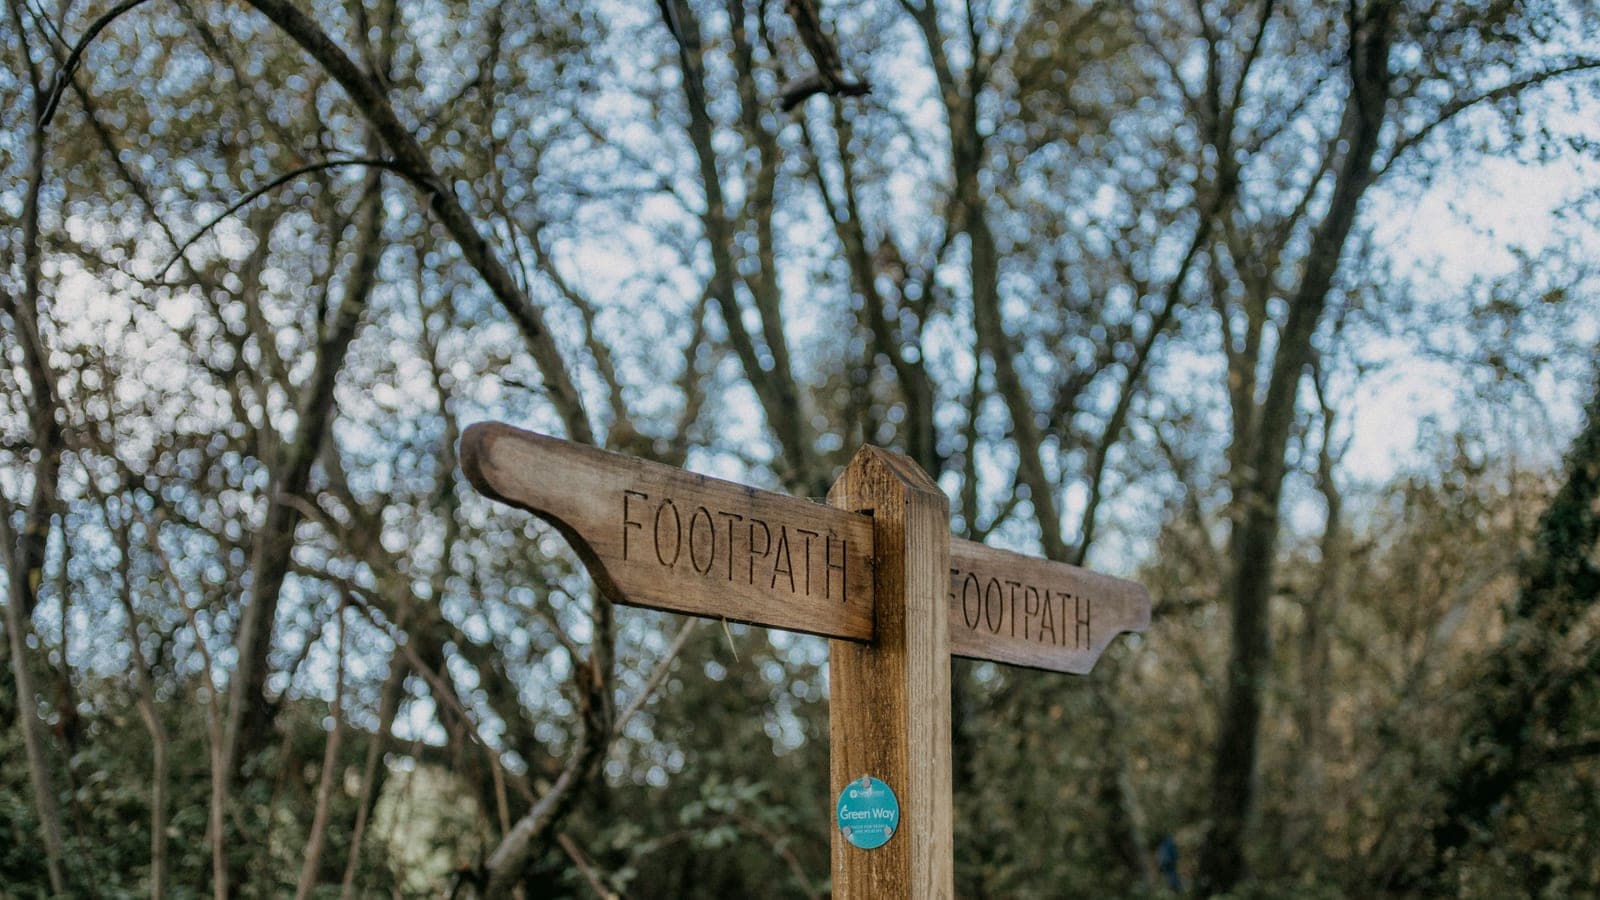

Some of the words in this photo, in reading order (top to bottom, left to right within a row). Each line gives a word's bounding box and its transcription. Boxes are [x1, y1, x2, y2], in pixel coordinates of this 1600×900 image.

[623, 489, 847, 603] FOOTPATH
[840, 805, 871, 820] Green
[872, 807, 896, 822] Way
